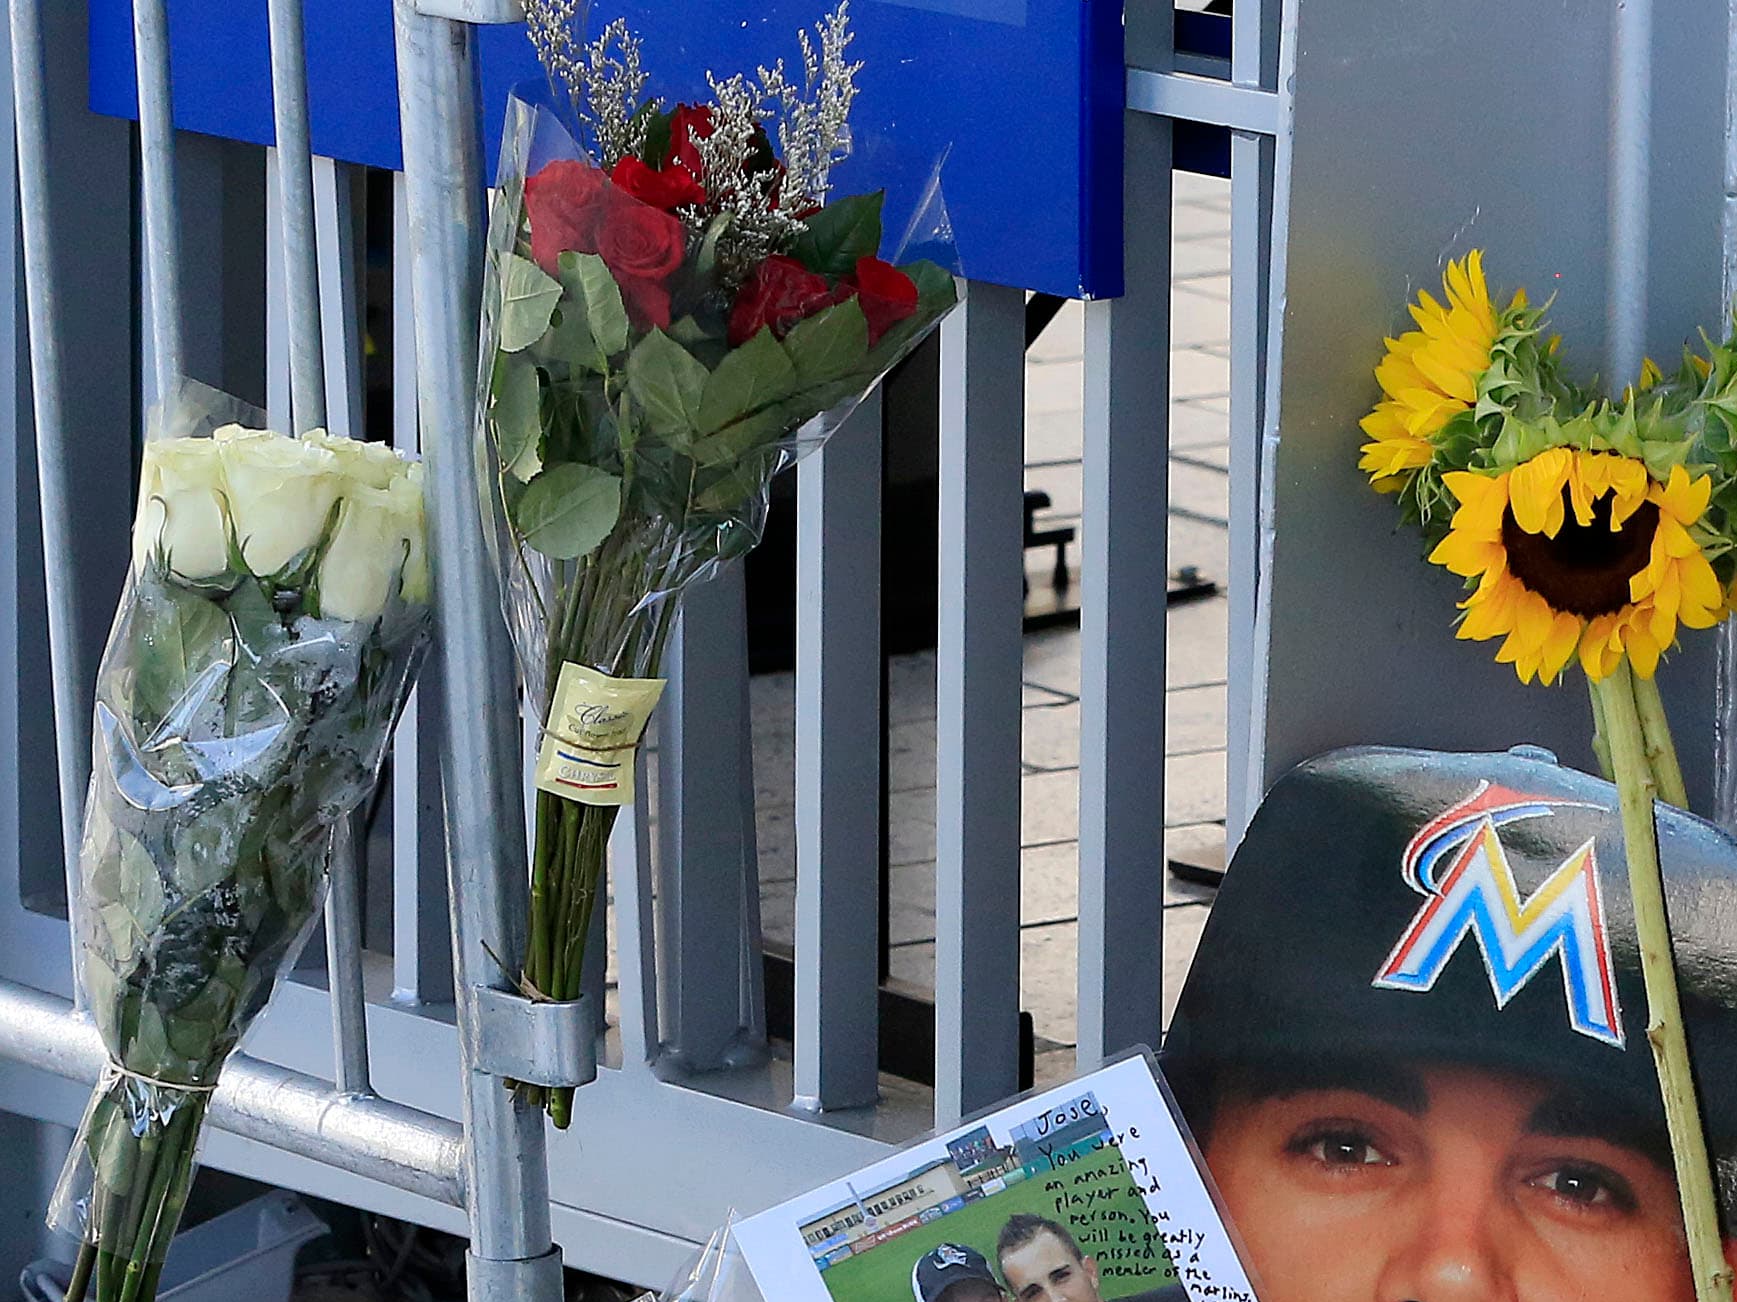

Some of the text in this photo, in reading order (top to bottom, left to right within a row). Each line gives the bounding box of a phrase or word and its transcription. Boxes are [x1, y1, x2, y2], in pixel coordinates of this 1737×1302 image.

[1038, 1126, 1140, 1171] You were
[1044, 1157, 1149, 1192] an amazing
[1053, 1176, 1161, 1213] player and
[1140, 1208, 1171, 1227] You
[1078, 1228, 1206, 1250] will be greatly
[1096, 1243, 1200, 1264] missed as a
[1102, 1263, 1211, 1281] member of the
